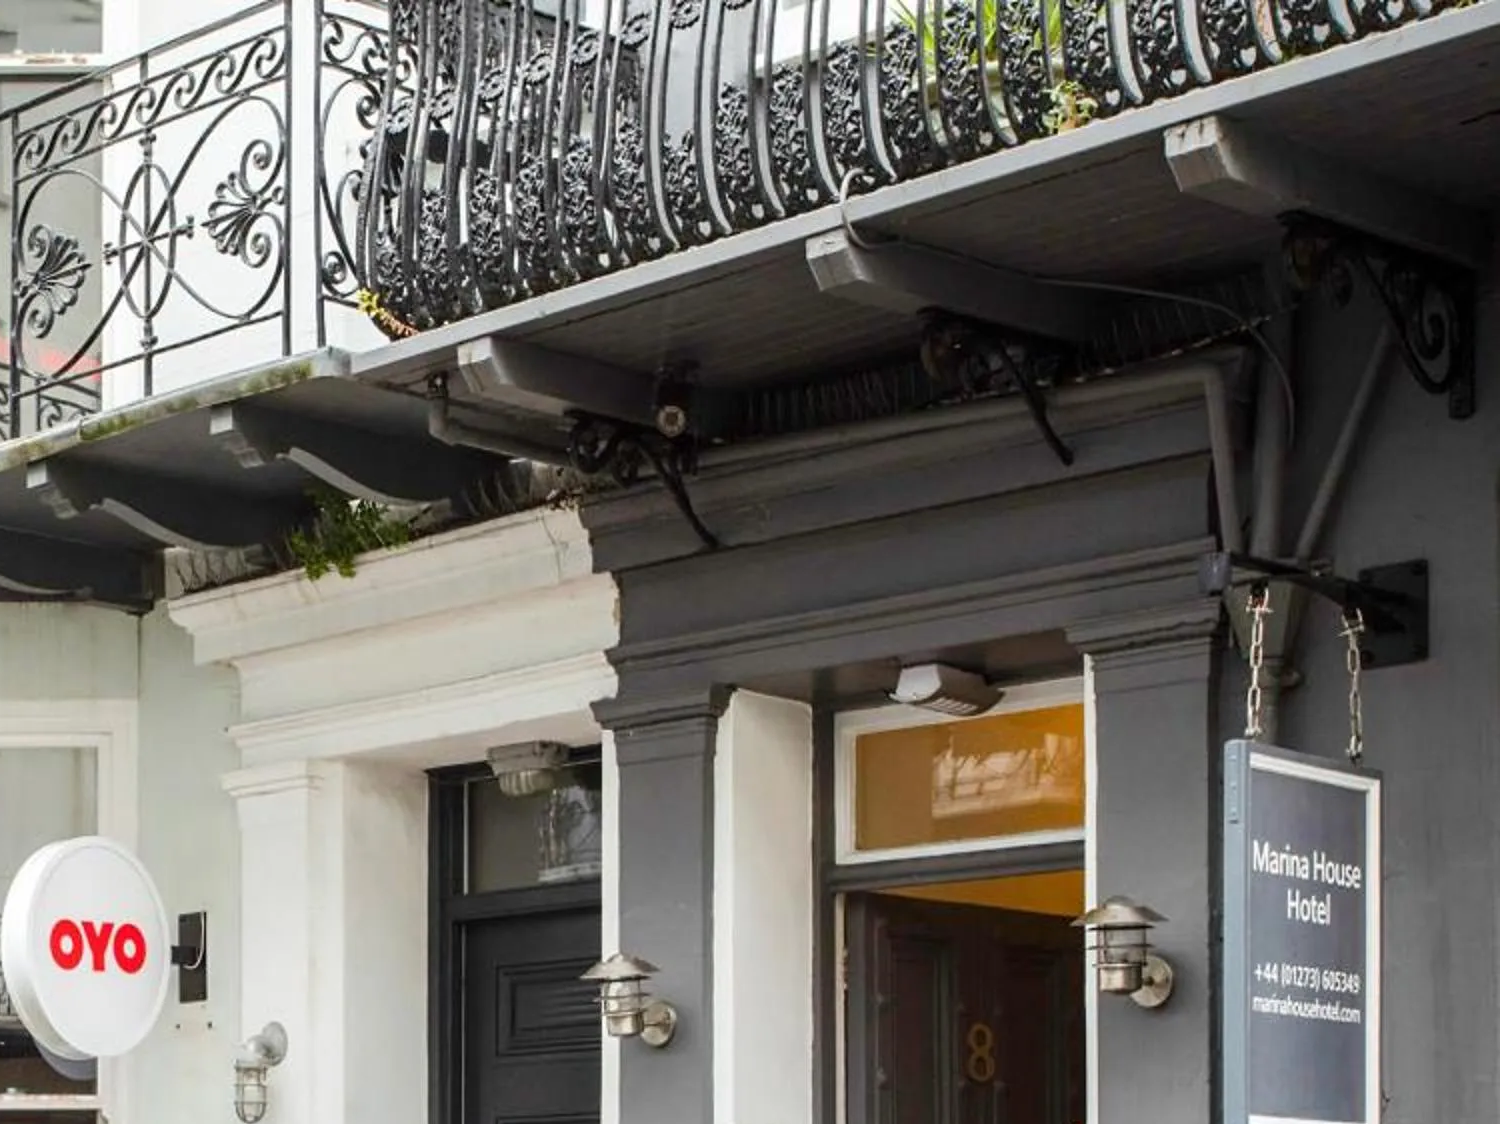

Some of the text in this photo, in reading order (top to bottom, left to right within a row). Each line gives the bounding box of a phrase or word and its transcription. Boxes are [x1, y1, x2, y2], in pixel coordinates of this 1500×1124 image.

[1253, 839, 1362, 889] Marina House
[1286, 888, 1332, 926] Hotel
[50, 919, 147, 974] OYO
[1253, 962, 1279, 984] +44
[1281, 963, 1321, 993] (01273)
[967, 1022, 996, 1082] 8
